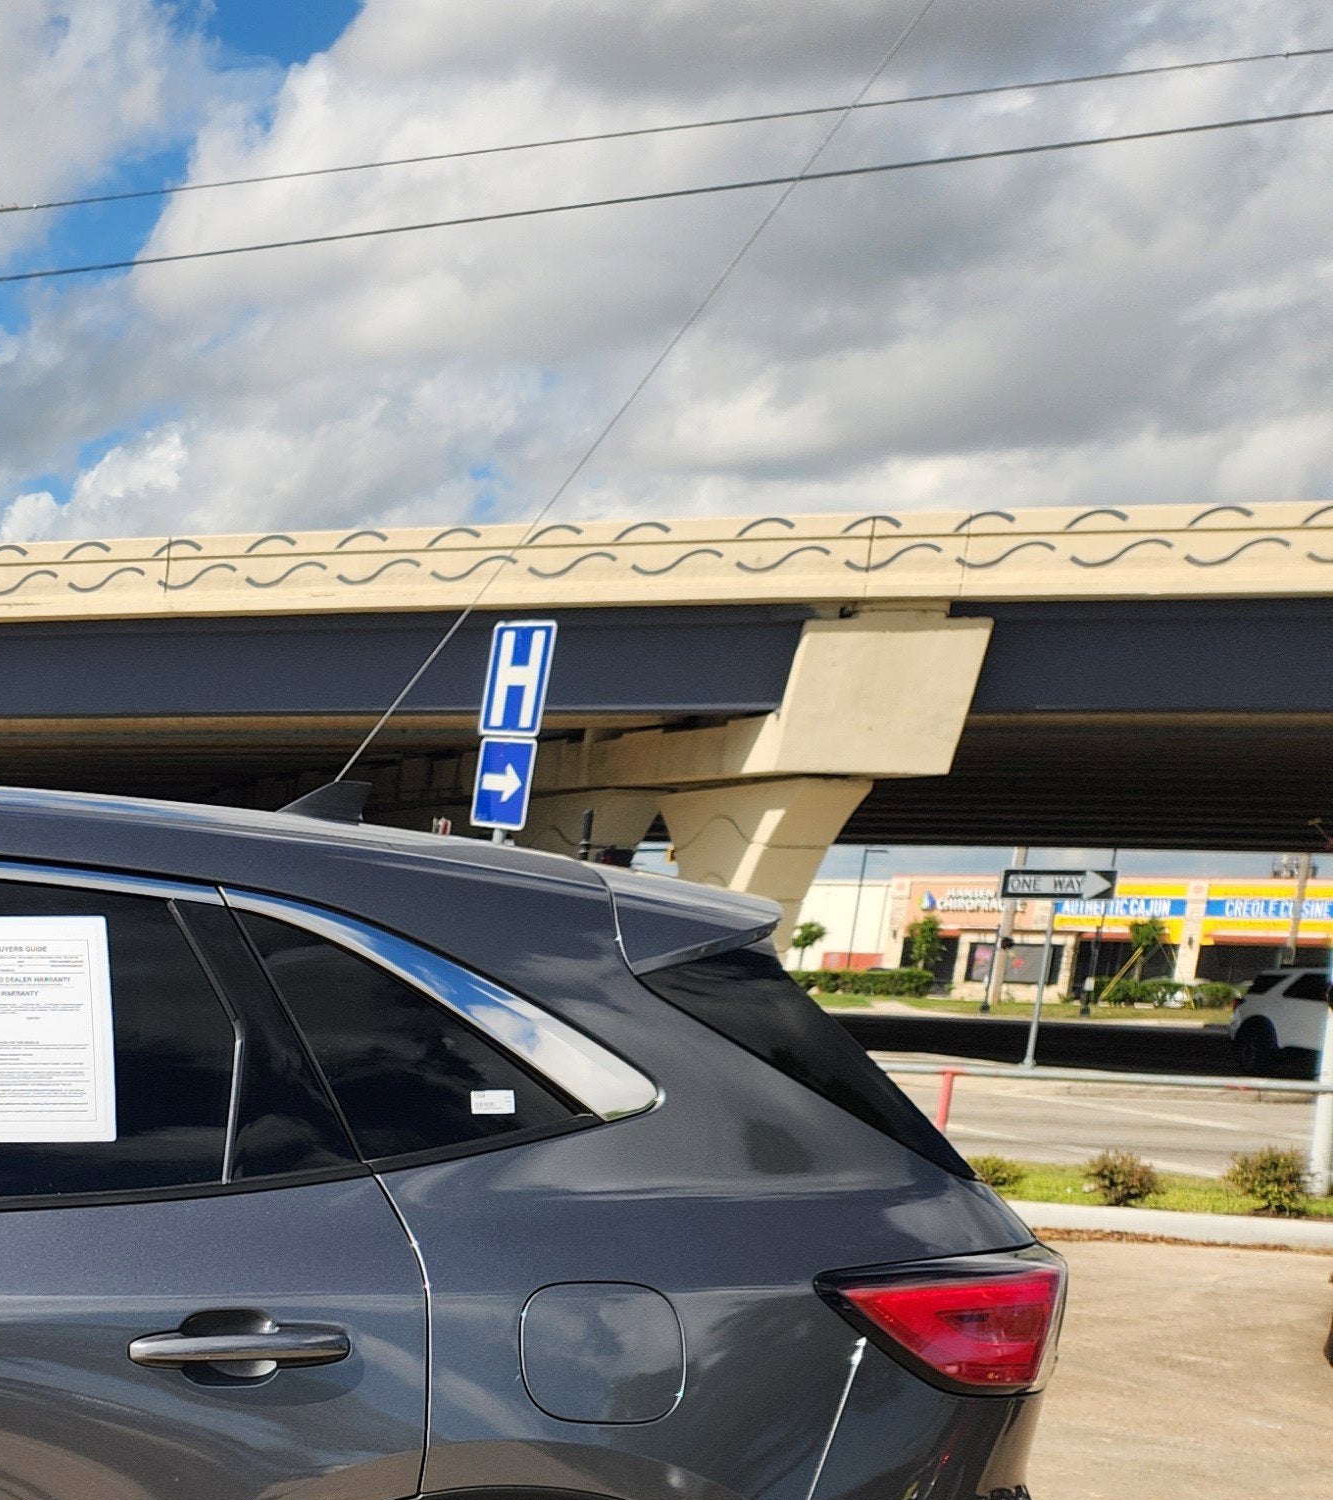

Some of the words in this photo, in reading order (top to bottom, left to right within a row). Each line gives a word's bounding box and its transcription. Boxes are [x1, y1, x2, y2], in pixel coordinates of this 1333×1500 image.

[488, 629, 547, 728] H
[1010, 875, 1042, 892] ONE
[1053, 876, 1084, 893] WAY
[937, 897, 1028, 913] CHIROPRACC
[1062, 899, 1129, 915] AUTHETIC
[1129, 899, 1172, 916] CAJUN
[1224, 899, 1279, 917] CREOLE
[1279, 900, 1331, 918] CSINE
